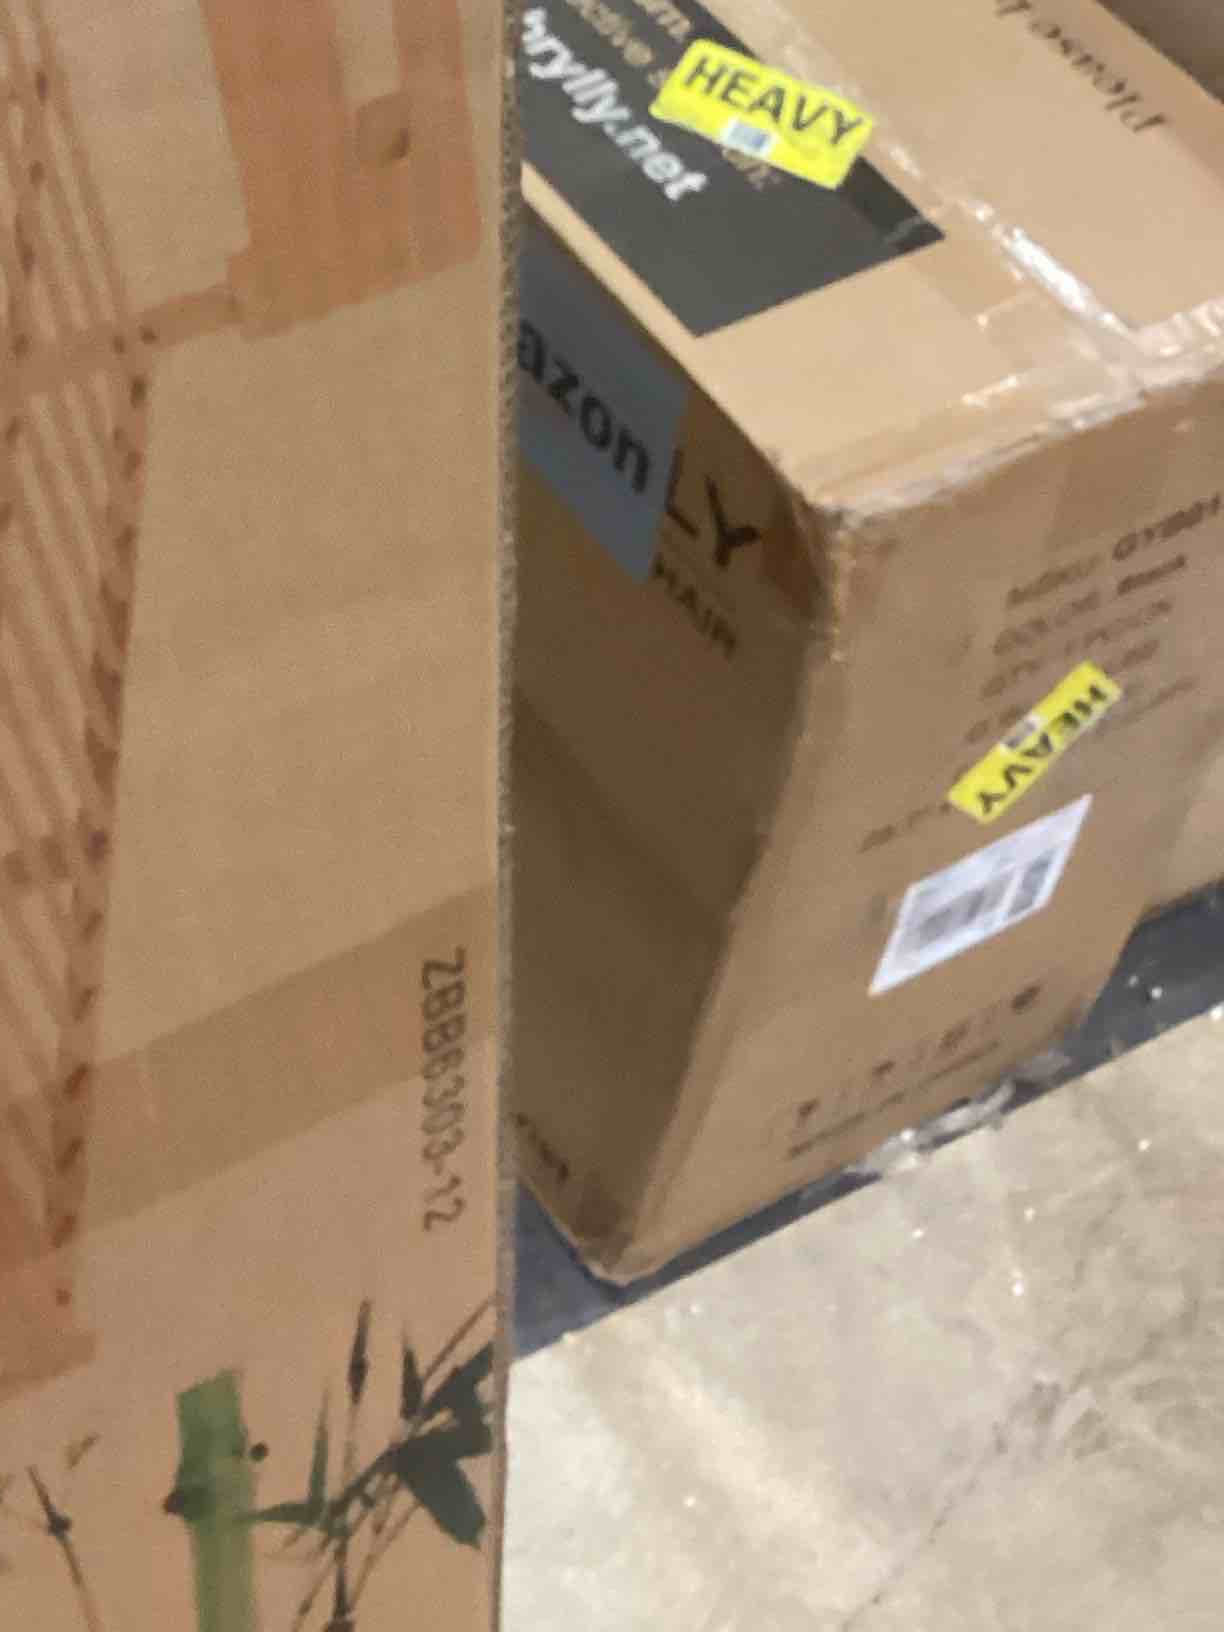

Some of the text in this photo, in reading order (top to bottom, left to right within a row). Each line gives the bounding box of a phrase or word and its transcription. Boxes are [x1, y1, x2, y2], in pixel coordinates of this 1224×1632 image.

[683, 55, 863, 147] HEAVY
[1026, 18, 1167, 133] Please
[517, 317, 651, 495] azon
[664, 448, 762, 567] LY
[976, 683, 1108, 815] HEAVY
